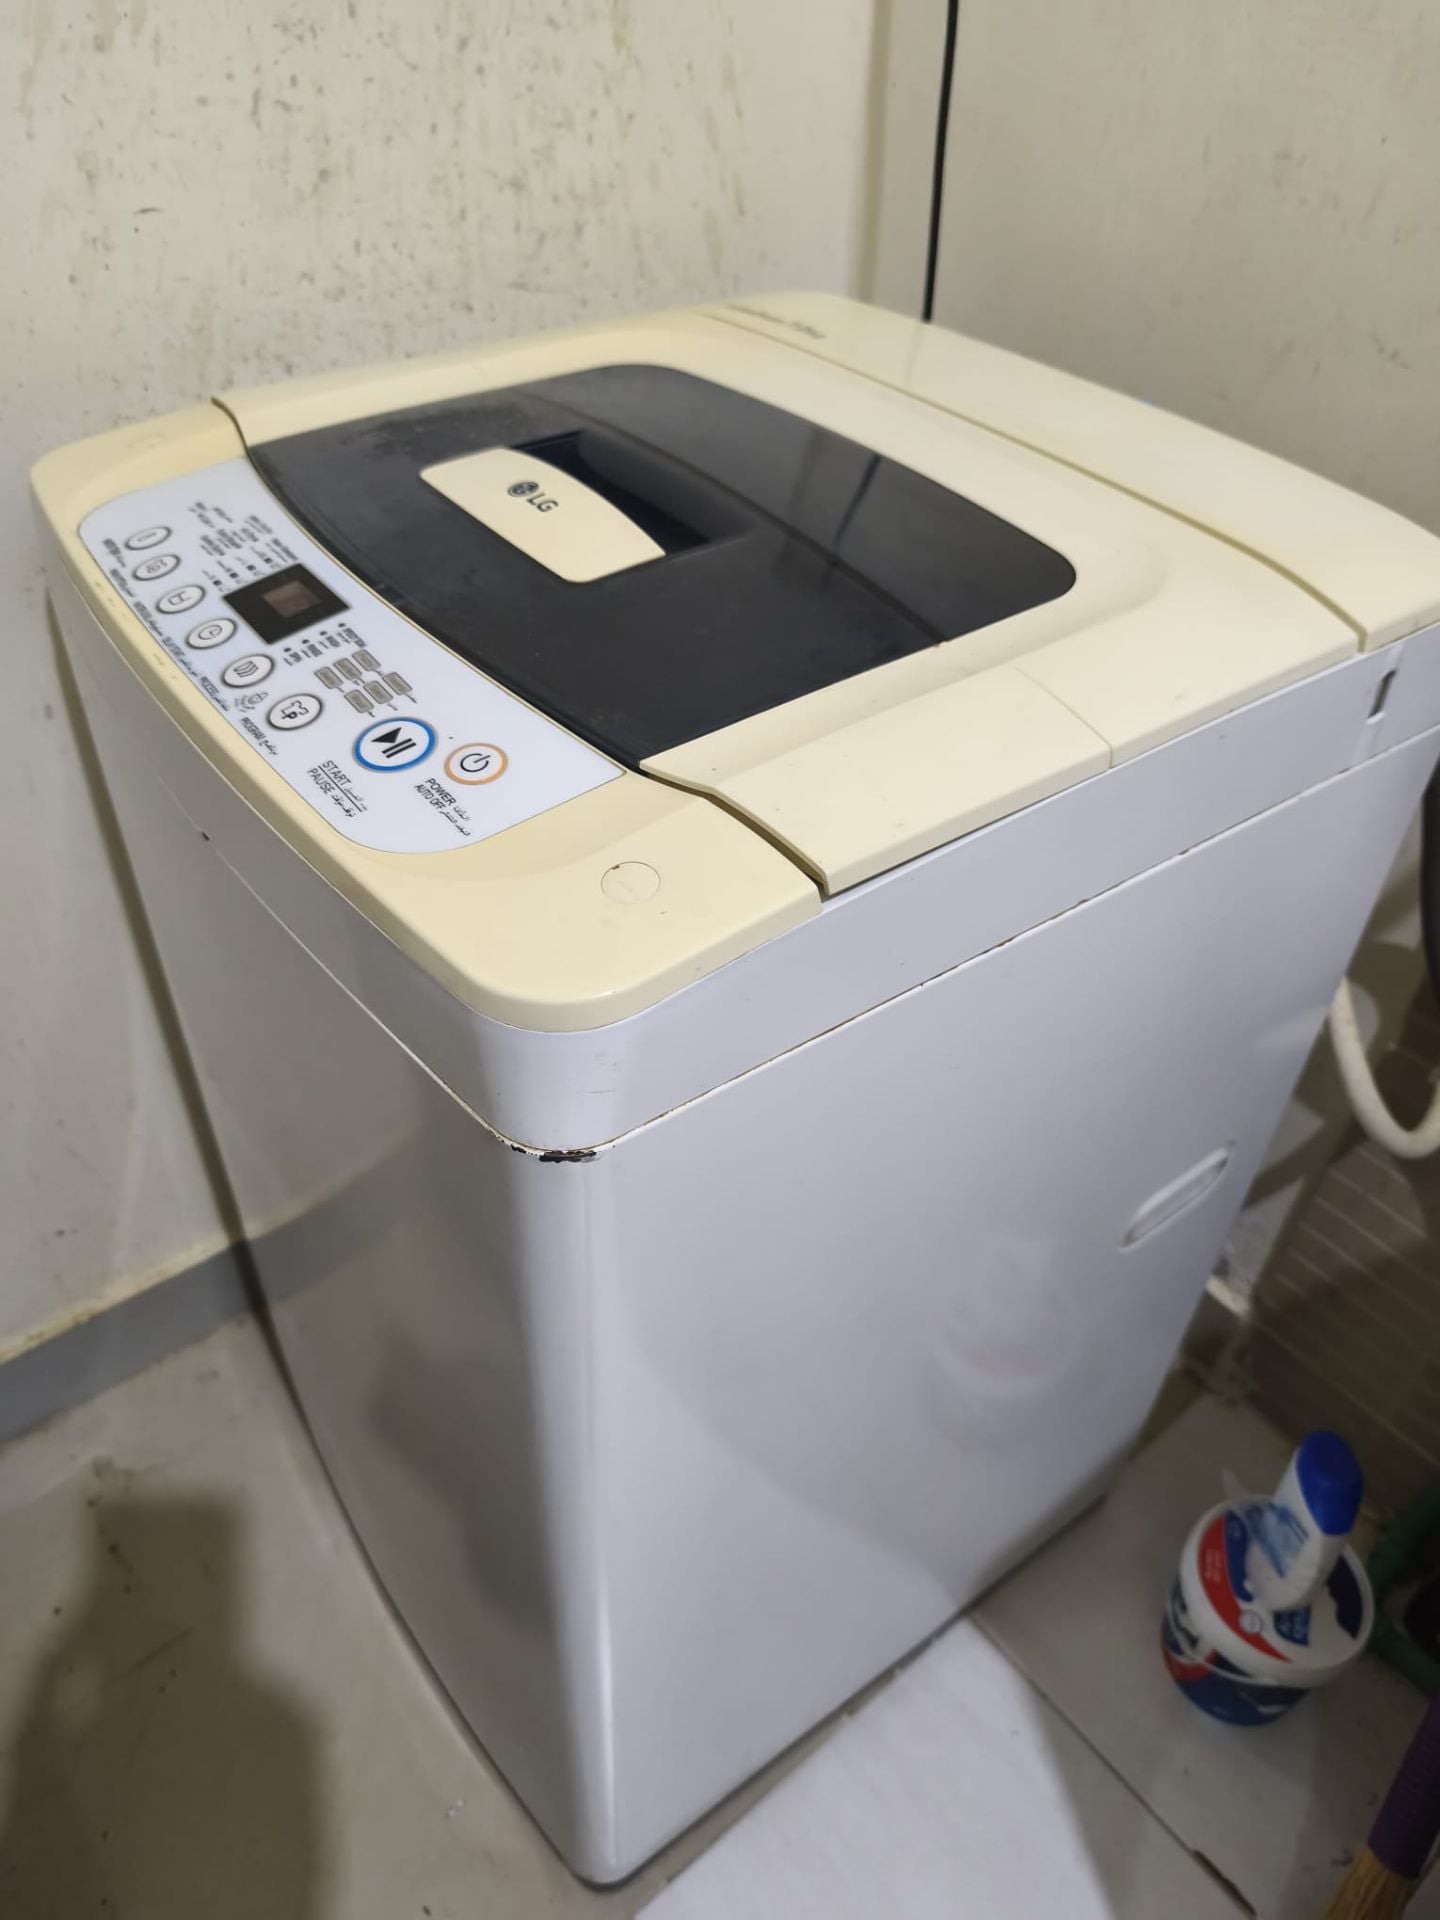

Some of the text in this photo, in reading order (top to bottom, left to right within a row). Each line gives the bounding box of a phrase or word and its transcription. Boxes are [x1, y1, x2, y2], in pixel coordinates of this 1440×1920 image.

[527, 492, 559, 513] LG
[306, 767, 336, 795] PAUSE
[322, 760, 352, 786] START
[414, 784, 447, 809] AUTO OFF
[425, 778, 457, 807] POWER
